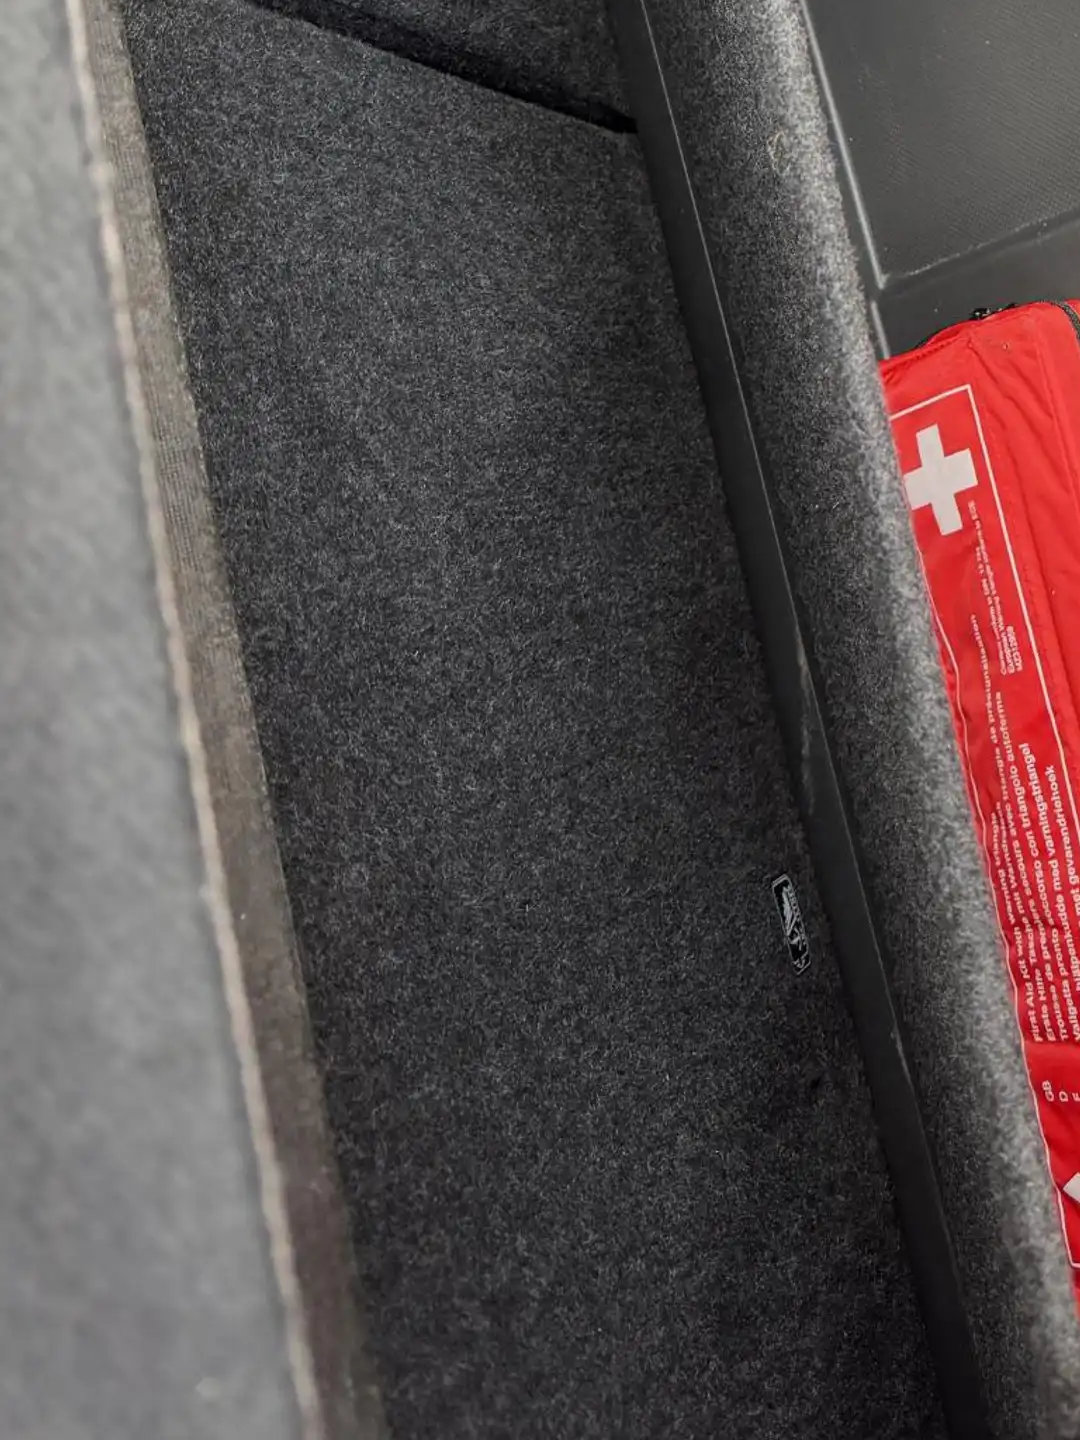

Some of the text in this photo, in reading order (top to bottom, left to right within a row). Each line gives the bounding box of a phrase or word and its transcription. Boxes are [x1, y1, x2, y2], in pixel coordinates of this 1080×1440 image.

[990, 727, 997, 743] de
[996, 748, 1008, 800] triangle
[1010, 765, 1030, 828] triangolo
[1006, 803, 1016, 836] avec
[1019, 743, 1055, 856] varningstriangel
[1026, 830, 1038, 857] con
[1045, 766, 1080, 885] gevarendriehoek
[1013, 840, 1031, 895] secours
[1048, 860, 1061, 890] med
[1014, 892, 1024, 914] mit
[1034, 860, 1054, 925] soccorso
[992, 813, 1054, 1101] GB First Aid Kit with warning triangle
[1022, 917, 1037, 965] Tasche
[1052, 928, 1068, 976] pronto
[1035, 969, 1046, 1001] Hilfe
[1045, 964, 1053, 981] de
[1042, 1004, 1056, 1041] Erste
[1050, 985, 1068, 1040] Trousse
[1059, 1091, 1068, 1102] D
